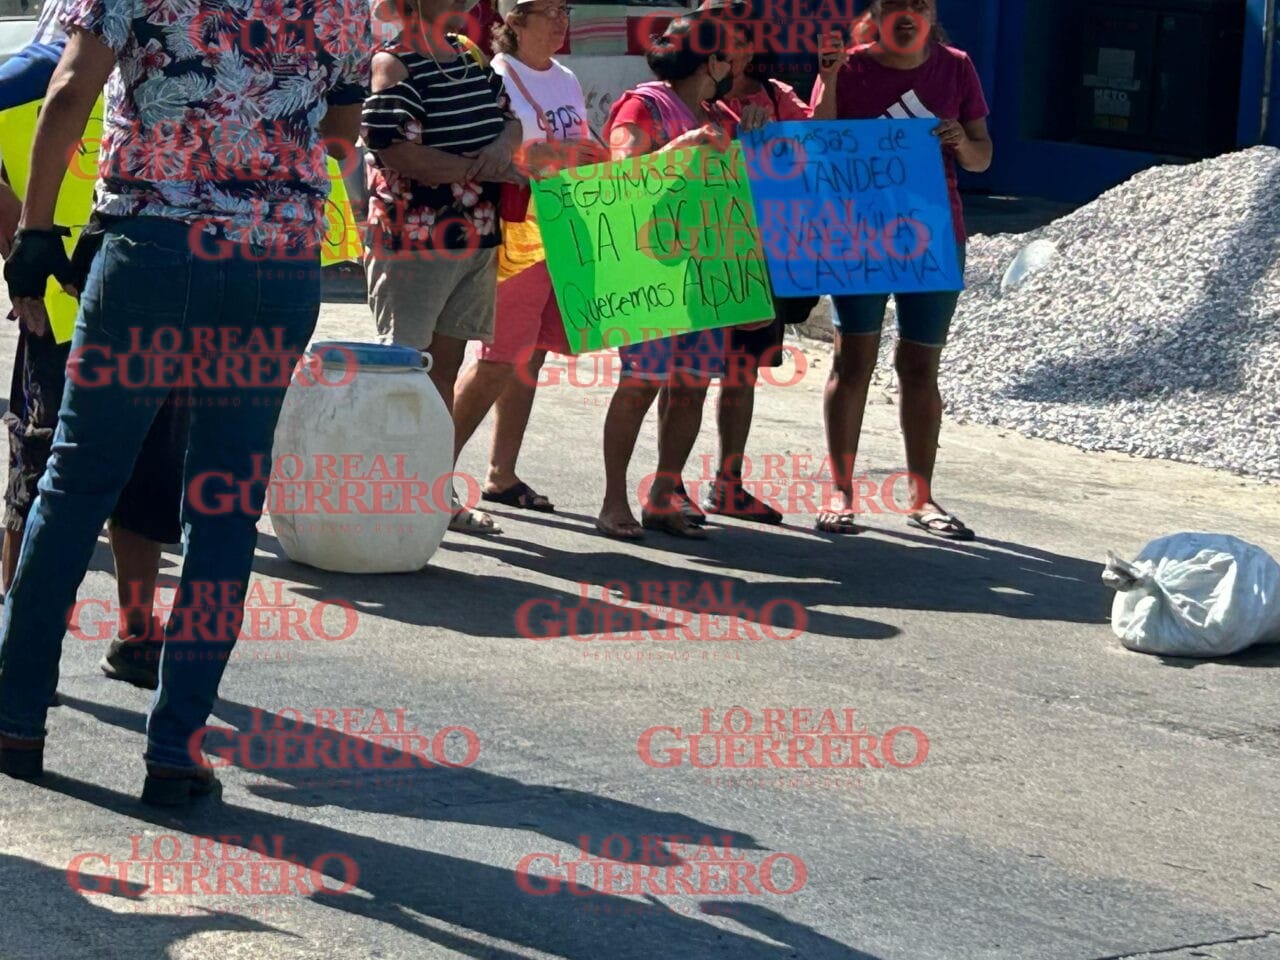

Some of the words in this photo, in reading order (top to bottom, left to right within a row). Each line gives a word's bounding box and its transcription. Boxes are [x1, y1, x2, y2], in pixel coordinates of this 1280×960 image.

[878, 124, 911, 152] de
[703, 152, 742, 190] EN
[788, 155, 907, 194] TANDEO
[569, 212, 621, 268] LA
[631, 196, 759, 254] LUCHA
[784, 244, 952, 292] CAPAMA
[562, 282, 675, 330] Queremos
